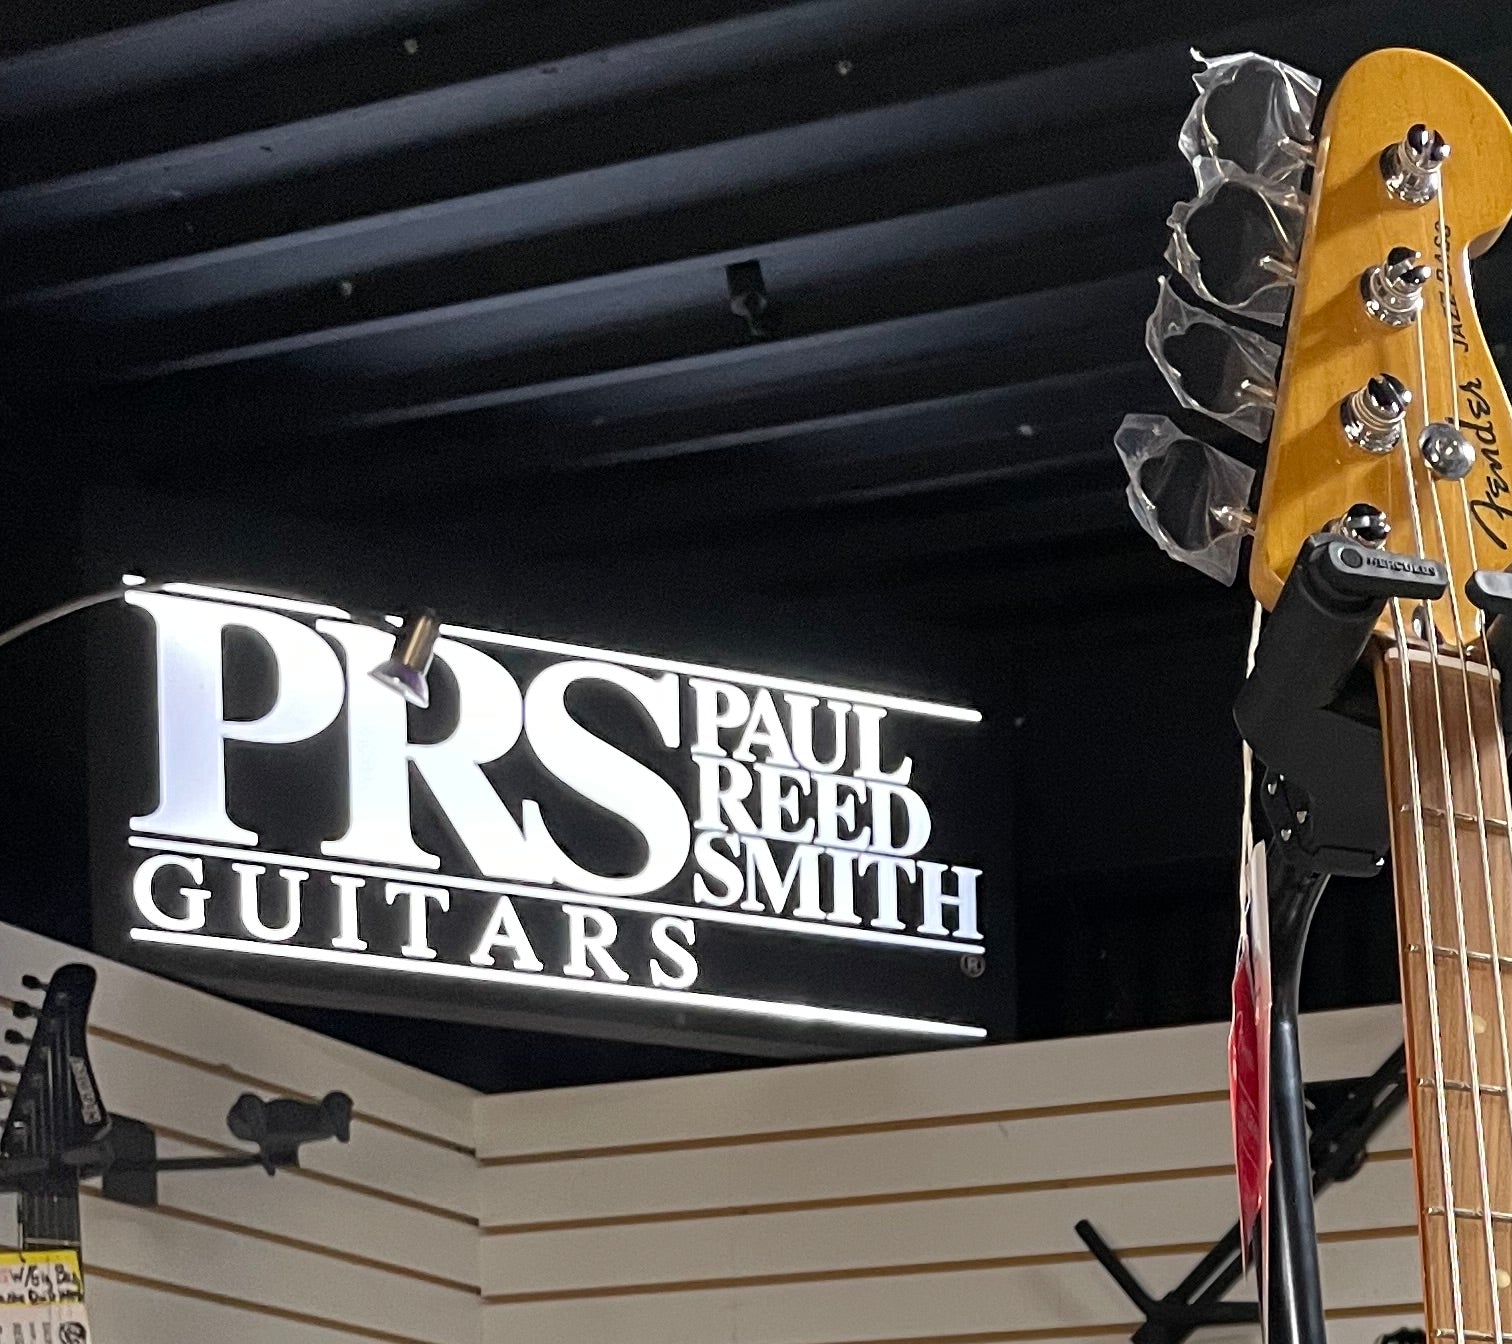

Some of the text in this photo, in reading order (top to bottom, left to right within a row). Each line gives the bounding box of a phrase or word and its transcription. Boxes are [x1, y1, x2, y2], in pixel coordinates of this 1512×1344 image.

[123, 588, 690, 898] PRS
[690, 677, 913, 786] PAUL
[691, 754, 932, 857] REED
[131, 854, 699, 989] GUITARS
[693, 829, 983, 941] SMITH
